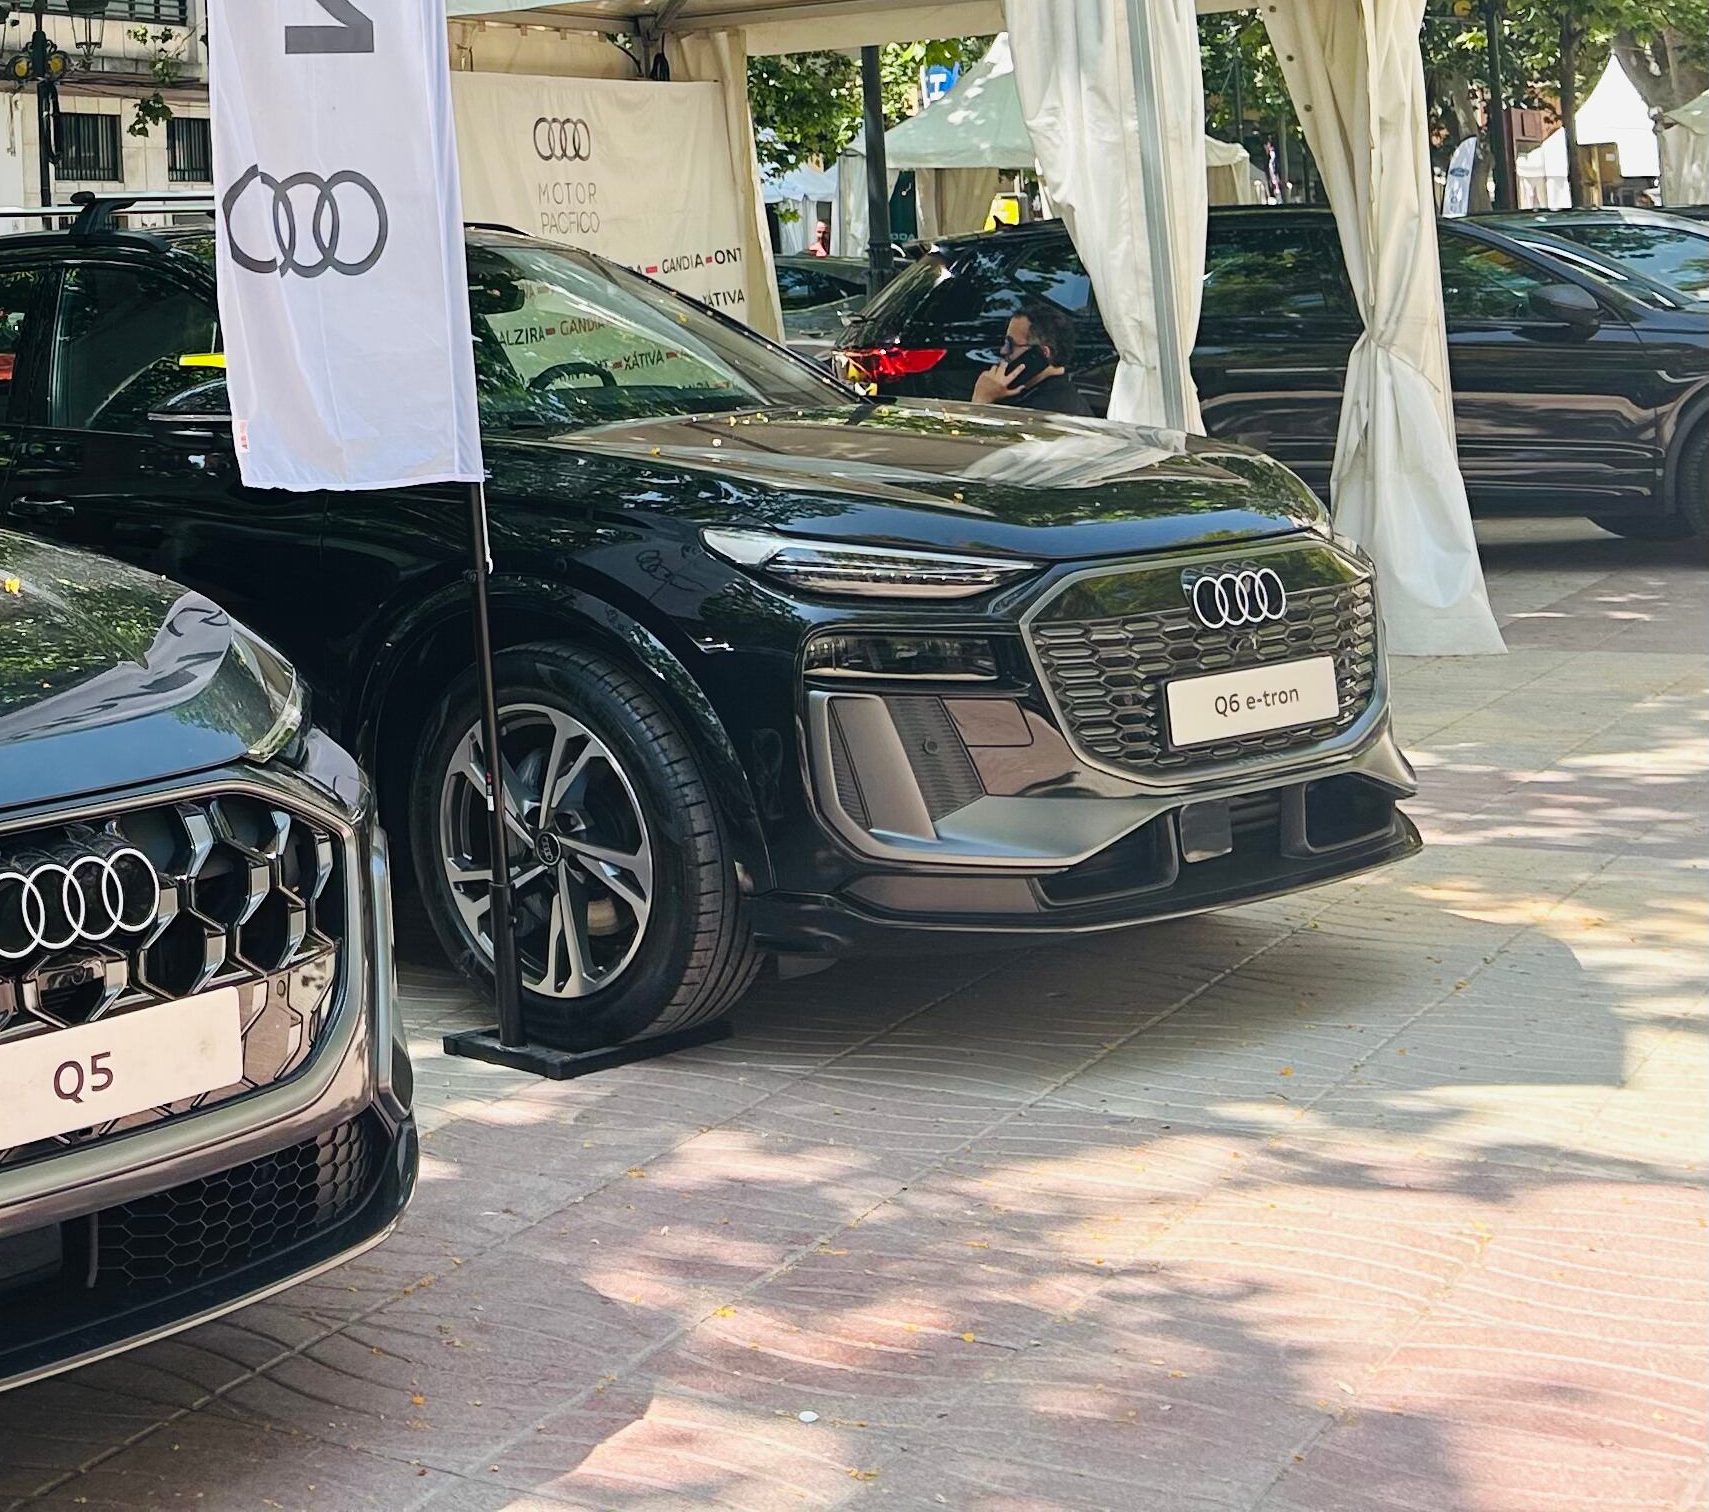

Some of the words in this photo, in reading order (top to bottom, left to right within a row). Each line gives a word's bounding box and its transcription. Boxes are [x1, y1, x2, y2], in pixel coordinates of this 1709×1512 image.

[538, 182, 598, 205] MOTOR
[662, 253, 705, 274] GANDIA
[1214, 693, 1240, 717] Q6
[1246, 687, 1300, 710] e-tron
[53, 1051, 115, 1104] Q5
